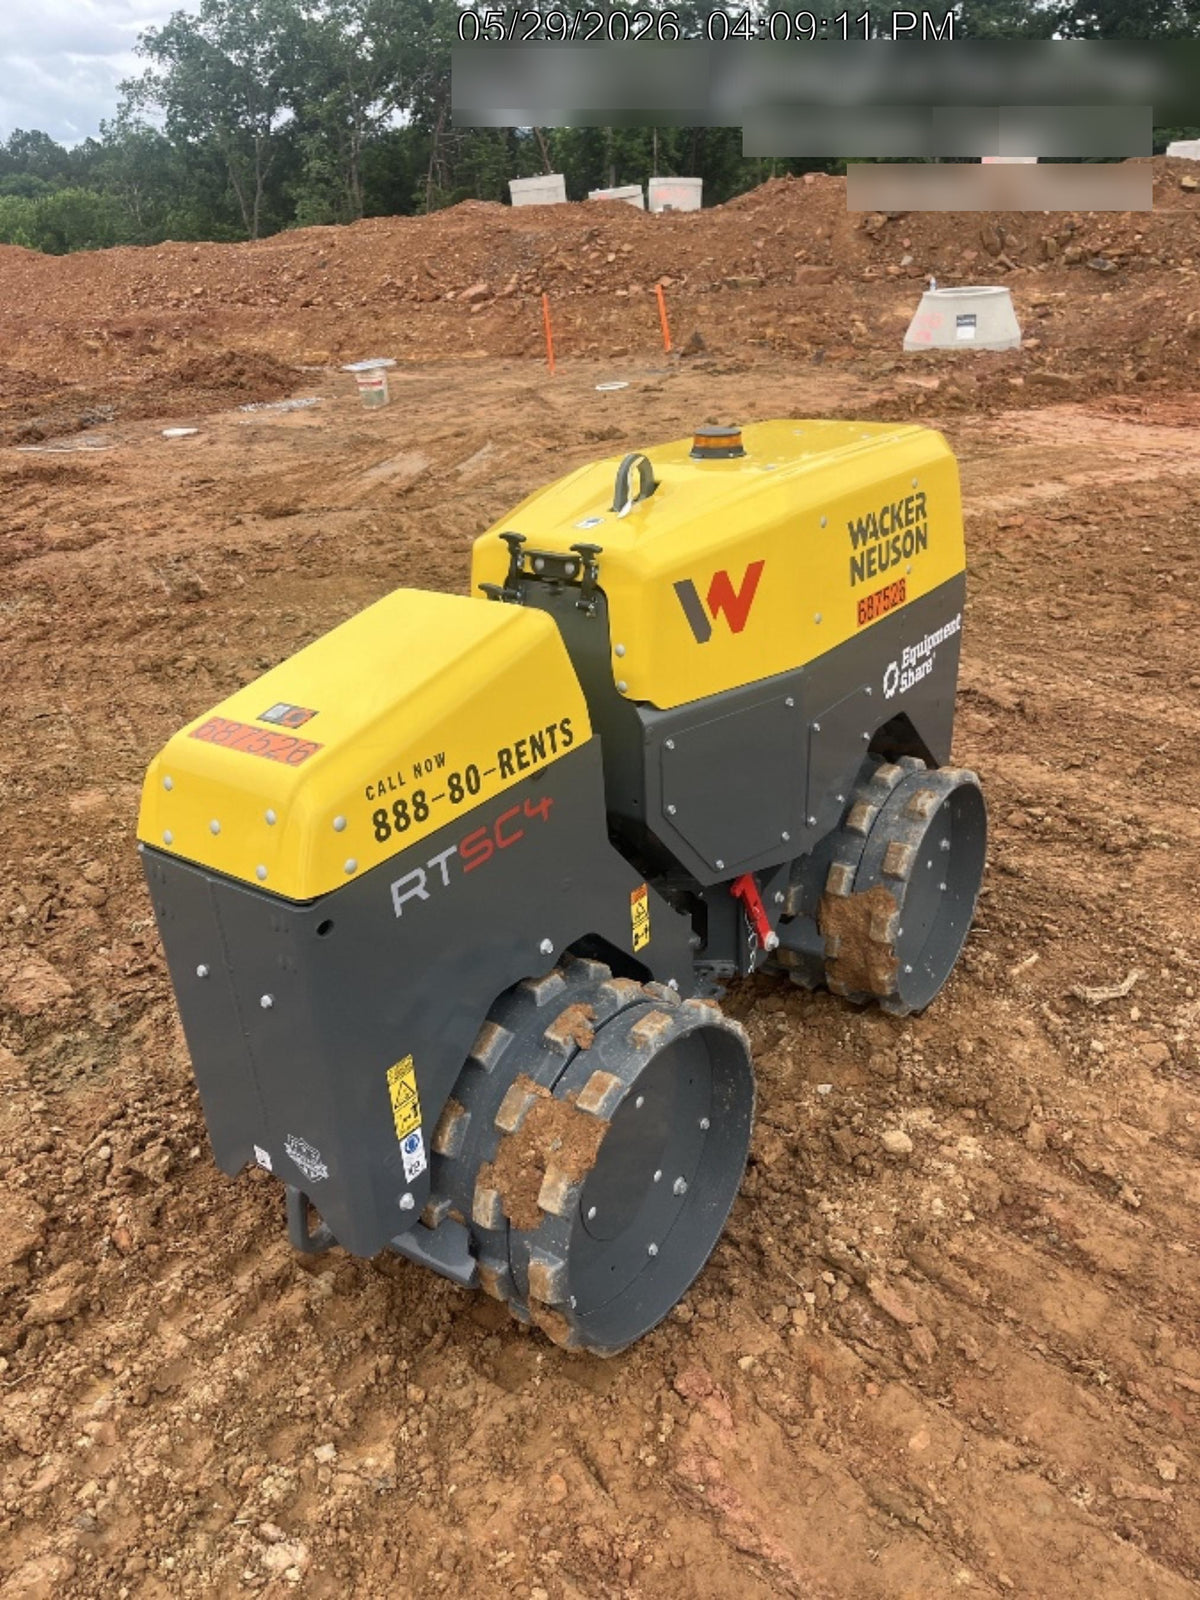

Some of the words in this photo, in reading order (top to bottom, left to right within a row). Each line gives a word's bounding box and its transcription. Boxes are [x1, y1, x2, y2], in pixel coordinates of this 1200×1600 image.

[847, 491, 928, 551] WACKER
[849, 522, 928, 587] NEUSON
[857, 578, 906, 626] 687526
[901, 613, 961, 669] Equipment
[899, 657, 933, 693] Share
[193, 717, 320, 764] 687526
[365, 771, 406, 801] CALL
[412, 751, 446, 779] NOW
[372, 717, 574, 843] 888-80-RENTS
